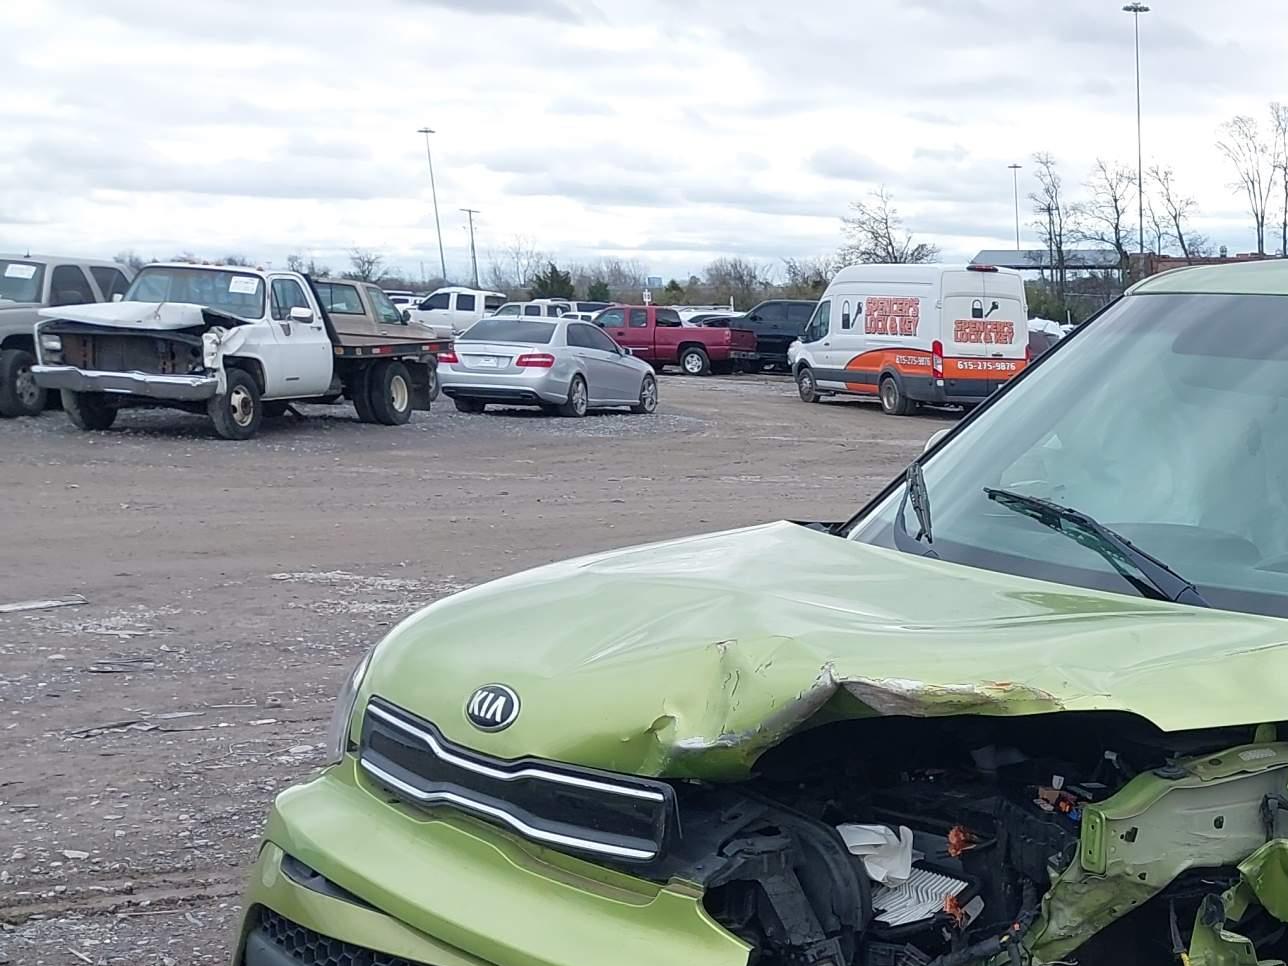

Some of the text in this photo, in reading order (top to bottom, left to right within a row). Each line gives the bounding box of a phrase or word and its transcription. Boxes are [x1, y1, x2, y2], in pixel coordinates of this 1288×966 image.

[865, 316, 888, 335] LOCK
[899, 317, 919, 336] KEY
[955, 330, 982, 343] LOCK
[994, 331, 1014, 344] KEY
[469, 690, 506, 722] KIA
